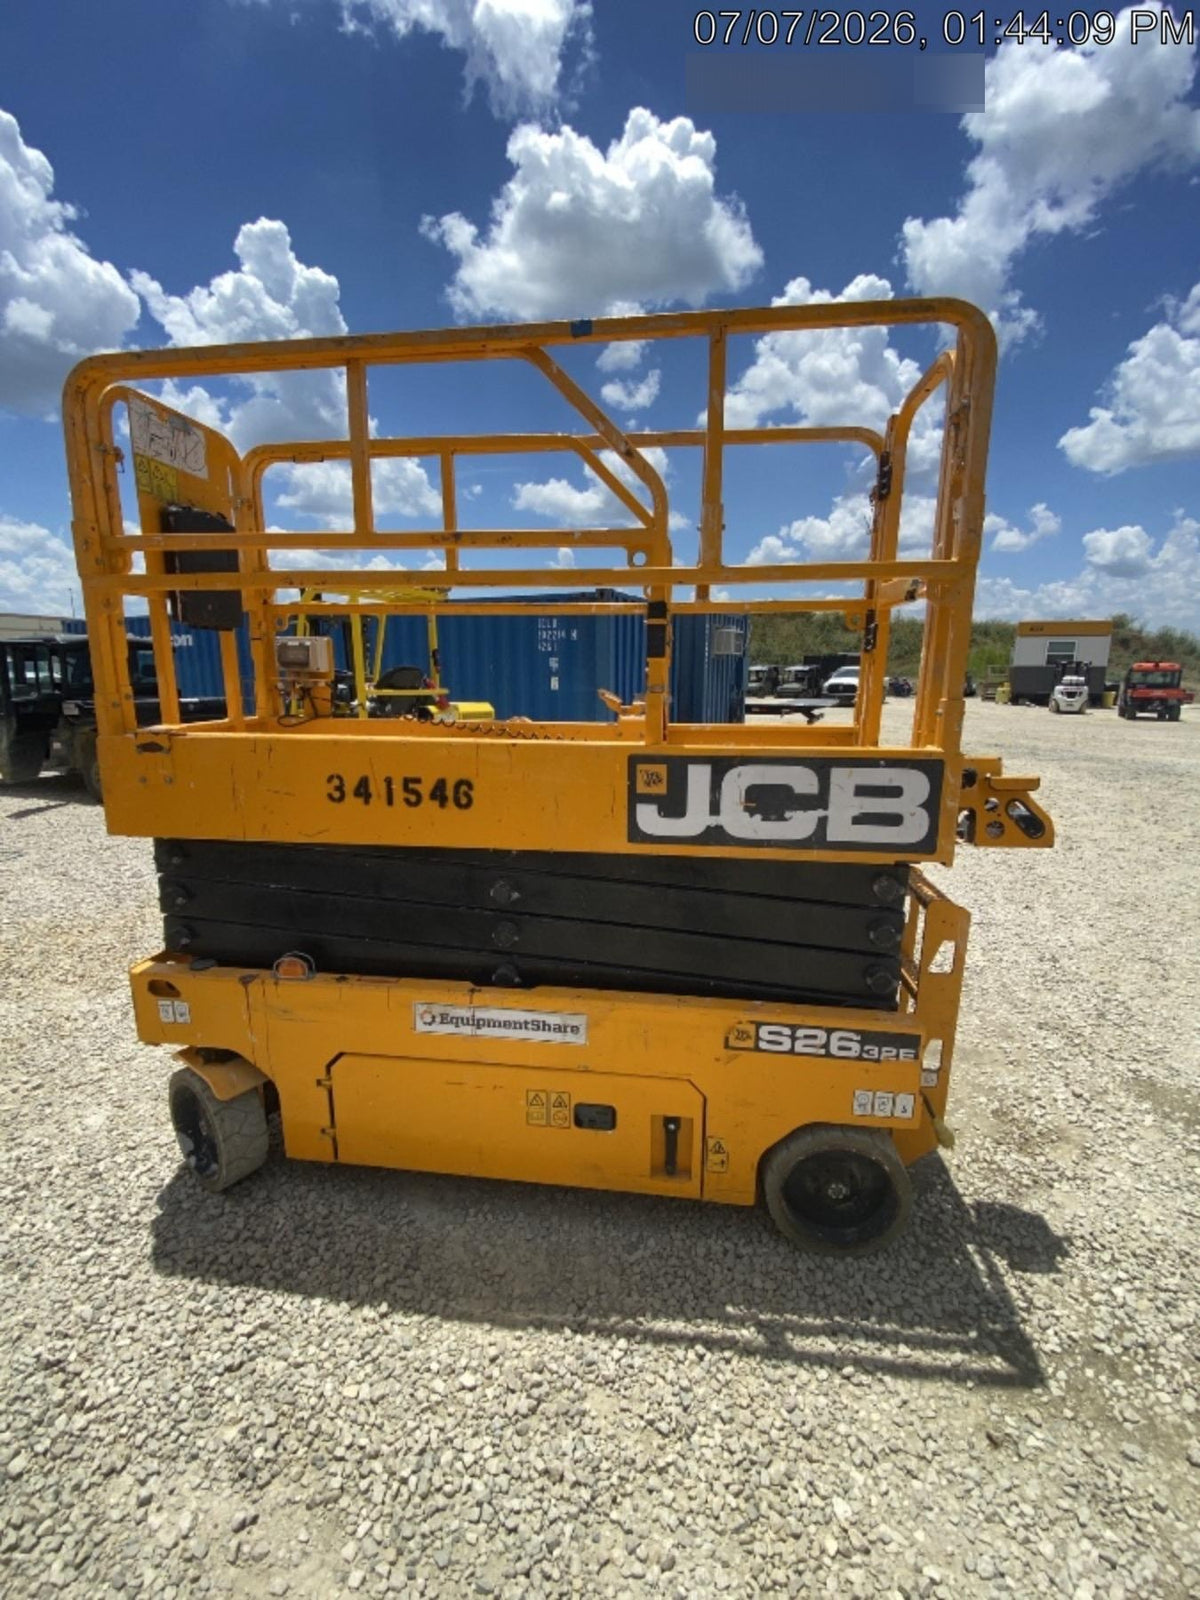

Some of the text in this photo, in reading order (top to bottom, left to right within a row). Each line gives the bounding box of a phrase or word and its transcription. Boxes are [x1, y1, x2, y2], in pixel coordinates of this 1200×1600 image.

[326, 774, 474, 810] 341546
[636, 763, 931, 843] JCB
[439, 1013, 580, 1035] EquipmentShare
